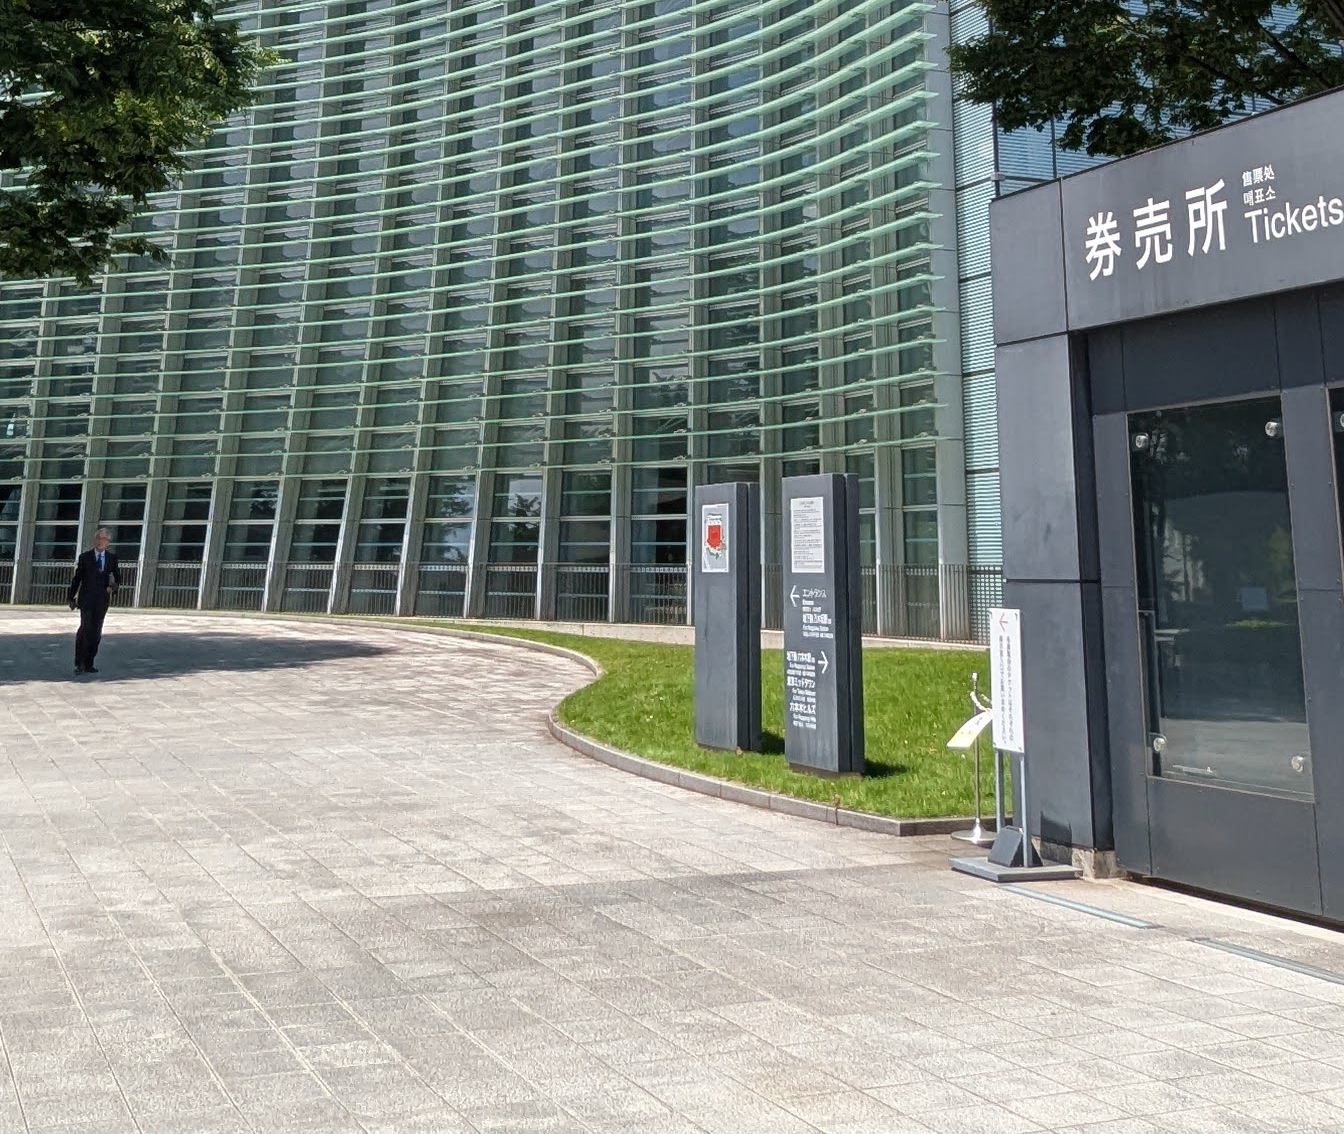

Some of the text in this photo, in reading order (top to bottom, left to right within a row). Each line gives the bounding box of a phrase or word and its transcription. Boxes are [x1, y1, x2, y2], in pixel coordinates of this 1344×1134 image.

[1085, 178, 1228, 281] 券売所
[1244, 194, 1344, 244] Tickets
